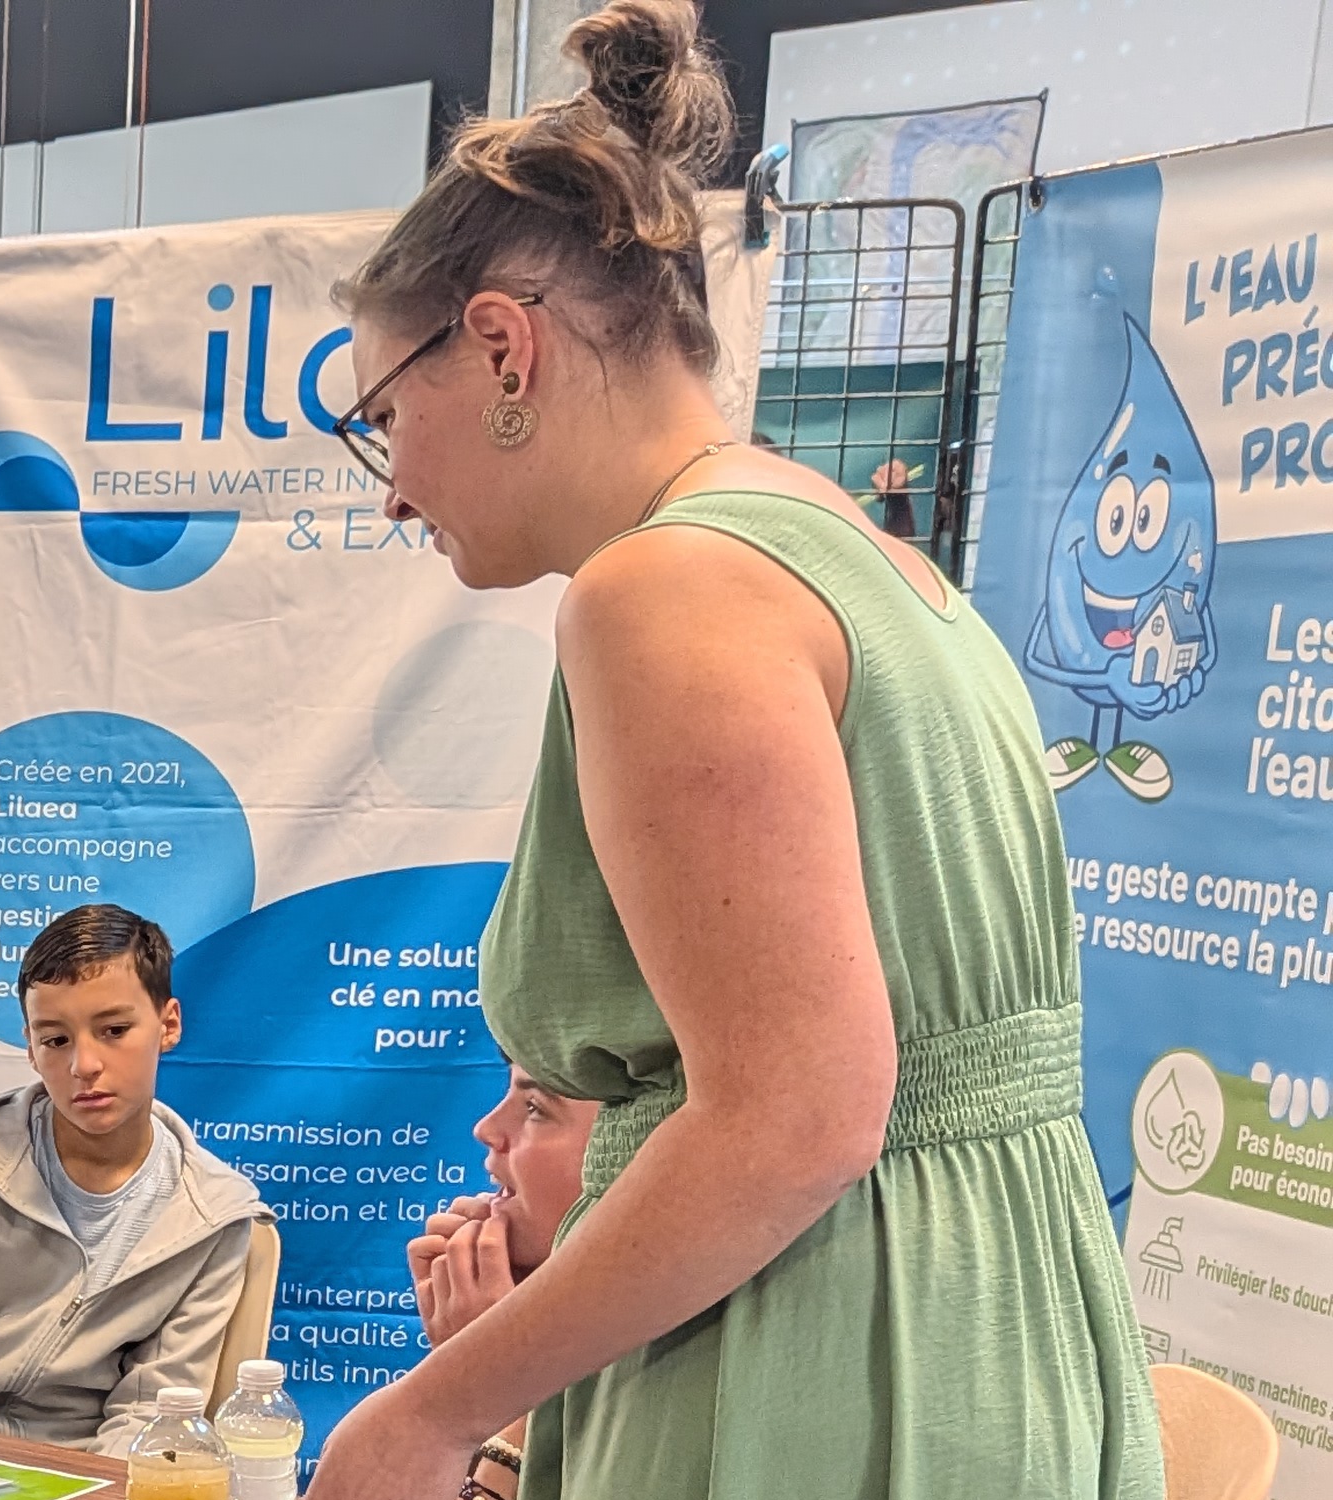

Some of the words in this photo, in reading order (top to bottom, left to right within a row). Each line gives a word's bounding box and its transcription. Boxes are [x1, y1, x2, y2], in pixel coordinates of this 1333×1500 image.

[1184, 233, 1318, 325] L'EAU
[93, 470, 196, 495] FRESH
[208, 468, 324, 494] WATER
[286, 509, 322, 551] &
[79, 765, 113, 783] en
[121, 761, 186, 788] 2021,
[48, 873, 101, 892] une
[1106, 861, 1189, 904] geste
[1195, 878, 1318, 926] compte
[328, 942, 391, 967] Une
[398, 942, 477, 968] solut
[1091, 914, 1240, 969] ressource
[1247, 929, 1275, 975] la
[330, 982, 376, 1007] clé
[383, 987, 420, 1008] en
[374, 1028, 452, 1053] pour
[194, 1118, 382, 1146] transmission
[392, 1122, 430, 1145] de
[1237, 1125, 1270, 1157] Pas
[1273, 1133, 1333, 1172] besoin
[356, 1165, 427, 1184] avec
[438, 1159, 465, 1184] la
[1230, 1165, 1274, 1191] pour
[1276, 1170, 1333, 1208] écono
[359, 1201, 388, 1221] et
[398, 1198, 425, 1222] la
[1196, 1254, 1267, 1296] Privilégier
[1269, 1276, 1291, 1303] les
[282, 1282, 416, 1312] l'interpré
[300, 1322, 408, 1349] qualité
[1232, 1370, 1255, 1392] vos
[1259, 1379, 1328, 1417] machines
